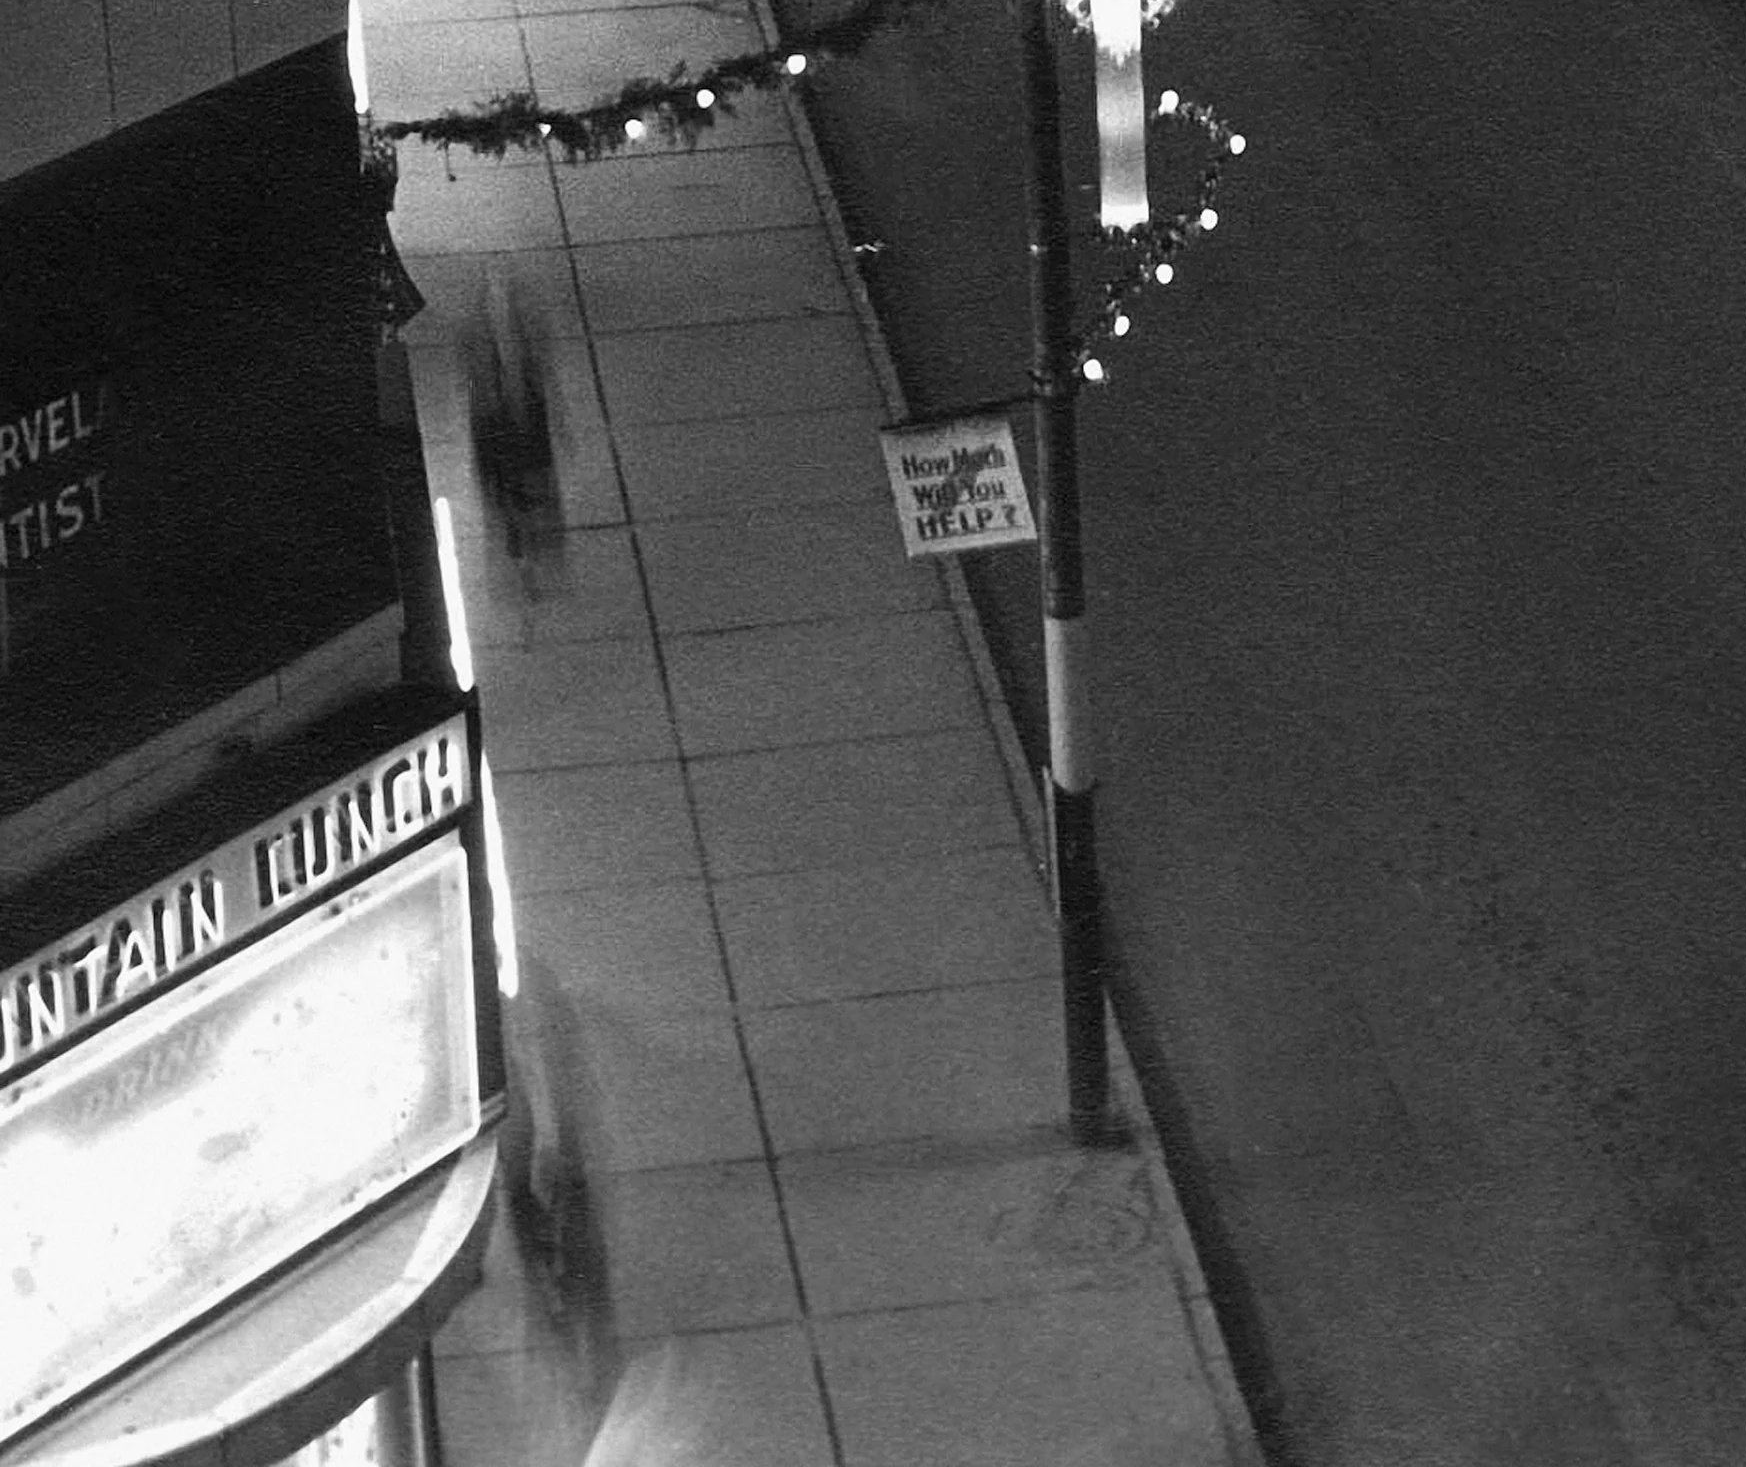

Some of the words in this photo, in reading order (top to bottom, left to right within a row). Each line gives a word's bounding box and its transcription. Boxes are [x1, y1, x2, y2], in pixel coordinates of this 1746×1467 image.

[901, 452, 950, 480] How
[958, 476, 1006, 505] You
[256, 739, 463, 907] LUNCH
